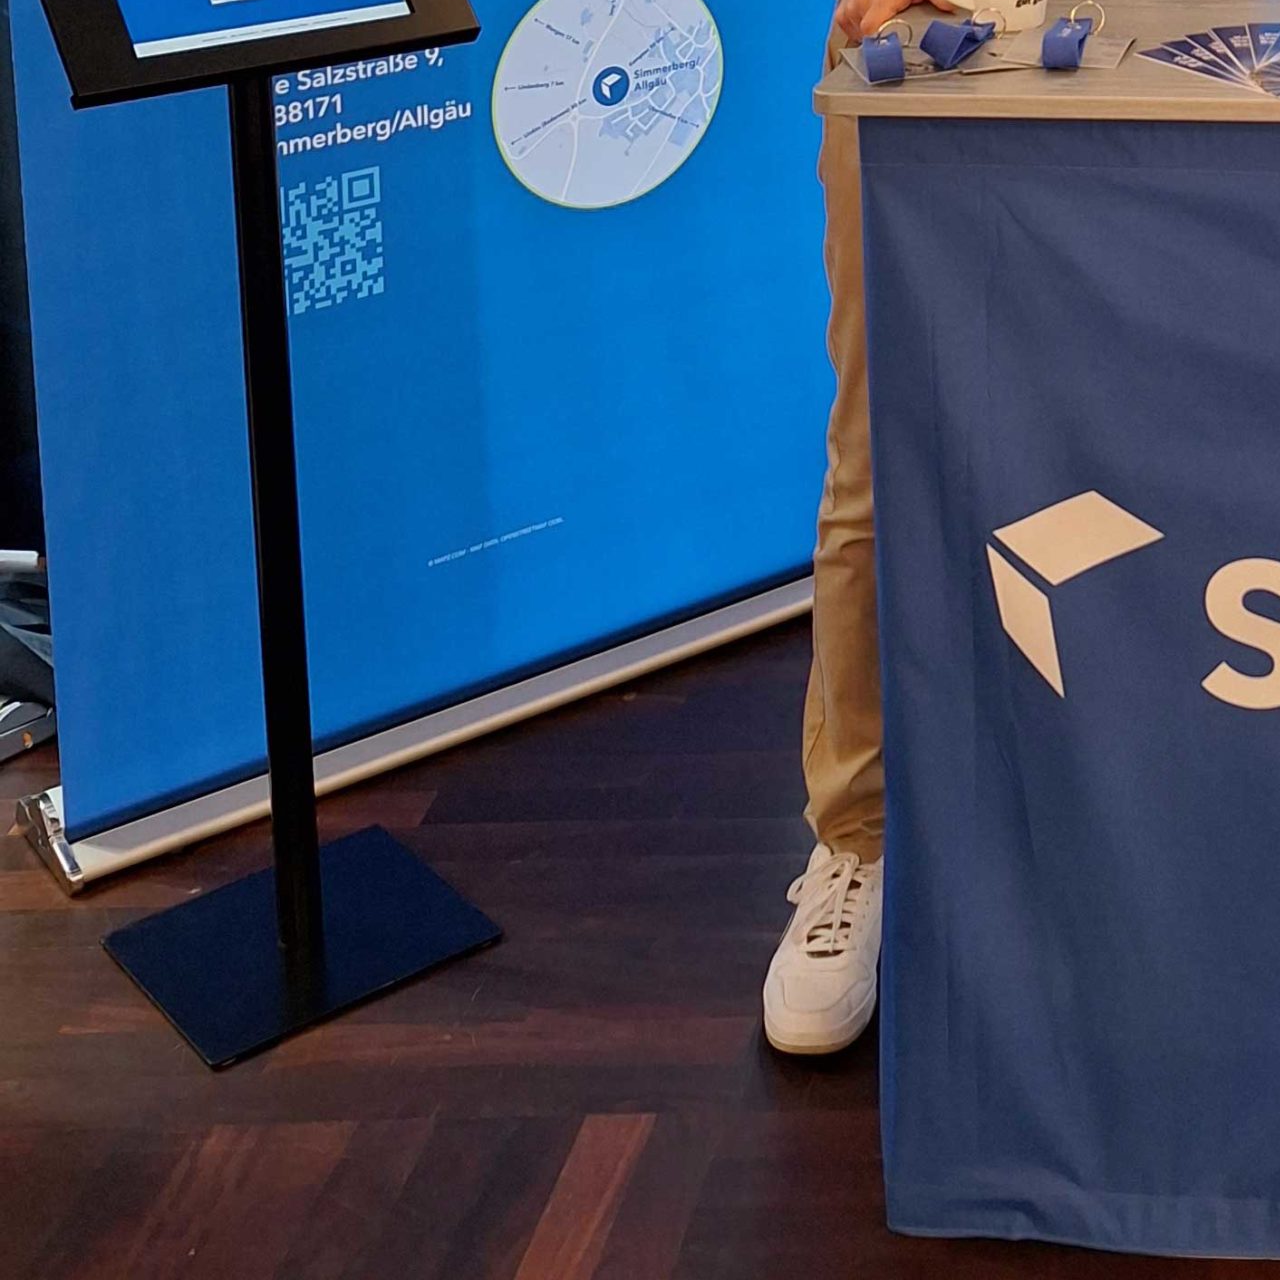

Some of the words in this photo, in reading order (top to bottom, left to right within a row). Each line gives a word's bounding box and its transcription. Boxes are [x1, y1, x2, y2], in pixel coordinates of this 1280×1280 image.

[297, 53, 417, 91] Salzstraße
[424, 48, 444, 67] 9,
[634, 56, 700, 79] Simmerberg/
[634, 78, 667, 91] Allgäu
[276, 102, 472, 156] merberg/Allgäu
